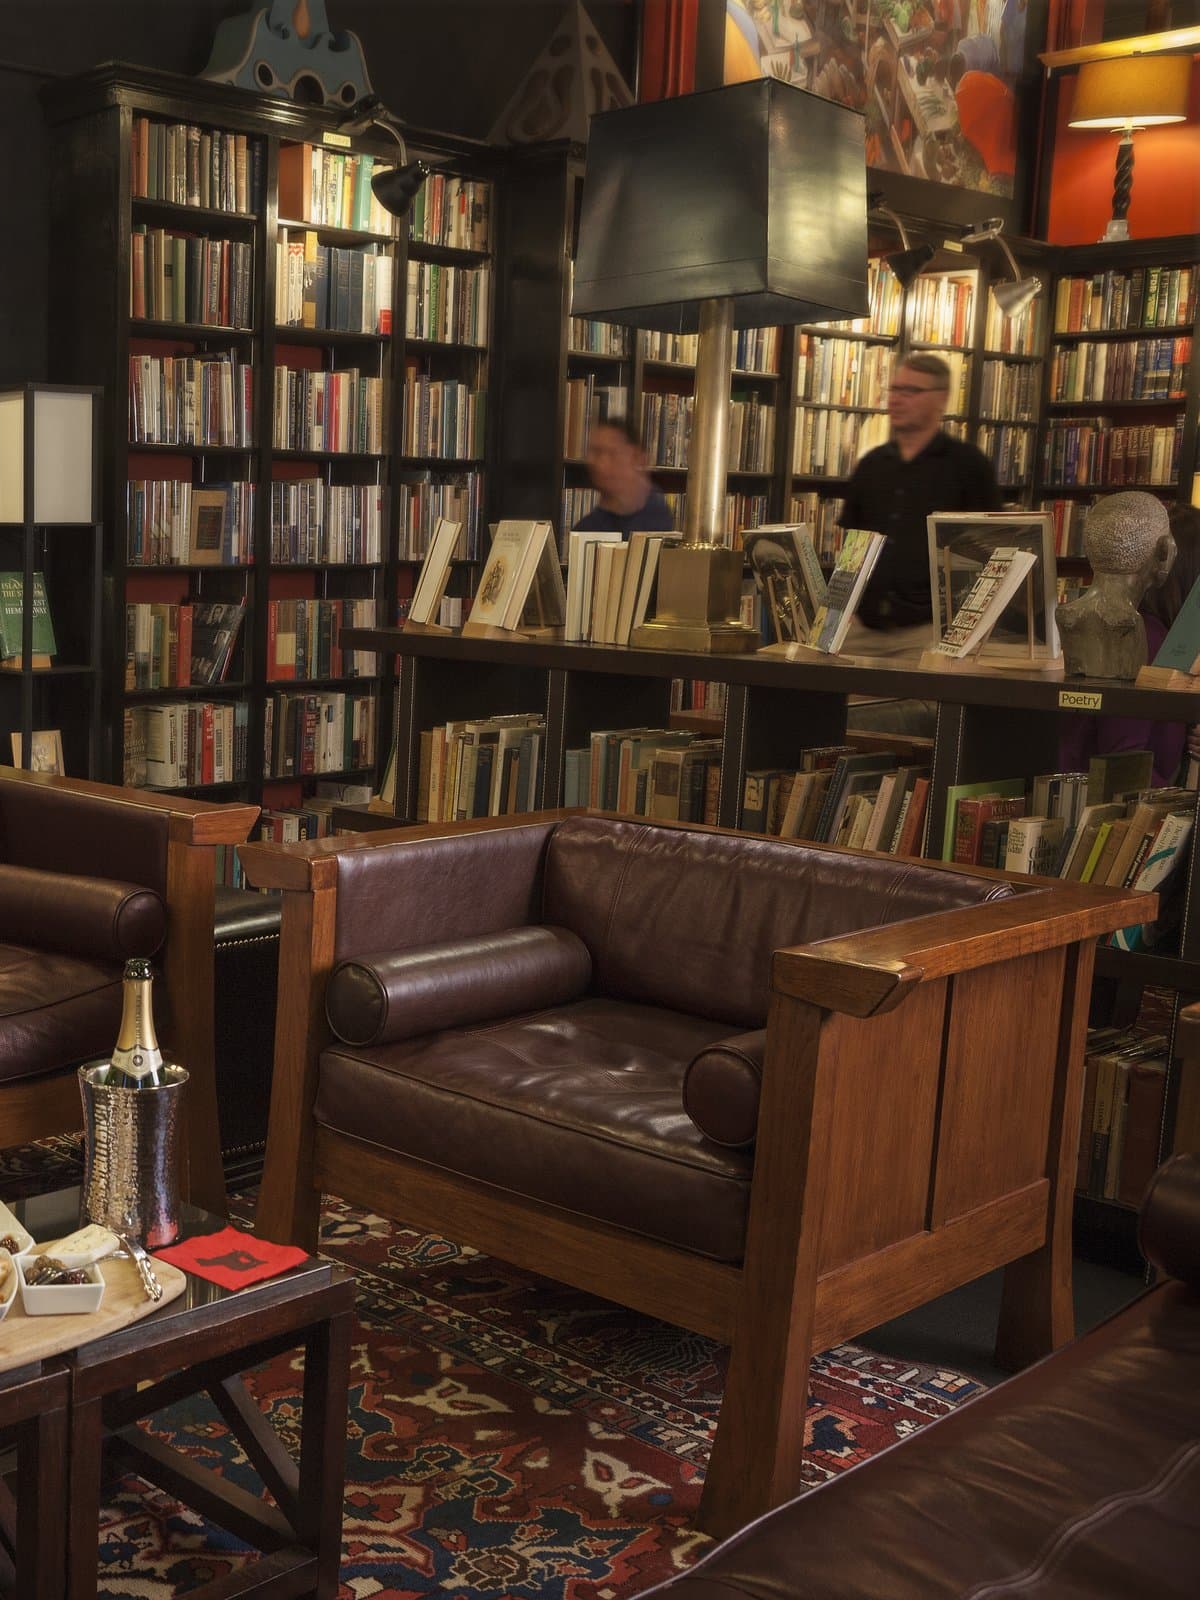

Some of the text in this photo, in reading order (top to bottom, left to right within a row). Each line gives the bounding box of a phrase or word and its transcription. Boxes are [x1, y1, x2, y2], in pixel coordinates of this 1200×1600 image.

[5, 607, 47, 616] HEMGWAY
[1061, 694, 1100, 709] Poetry
[991, 804, 1017, 815] POEMS
